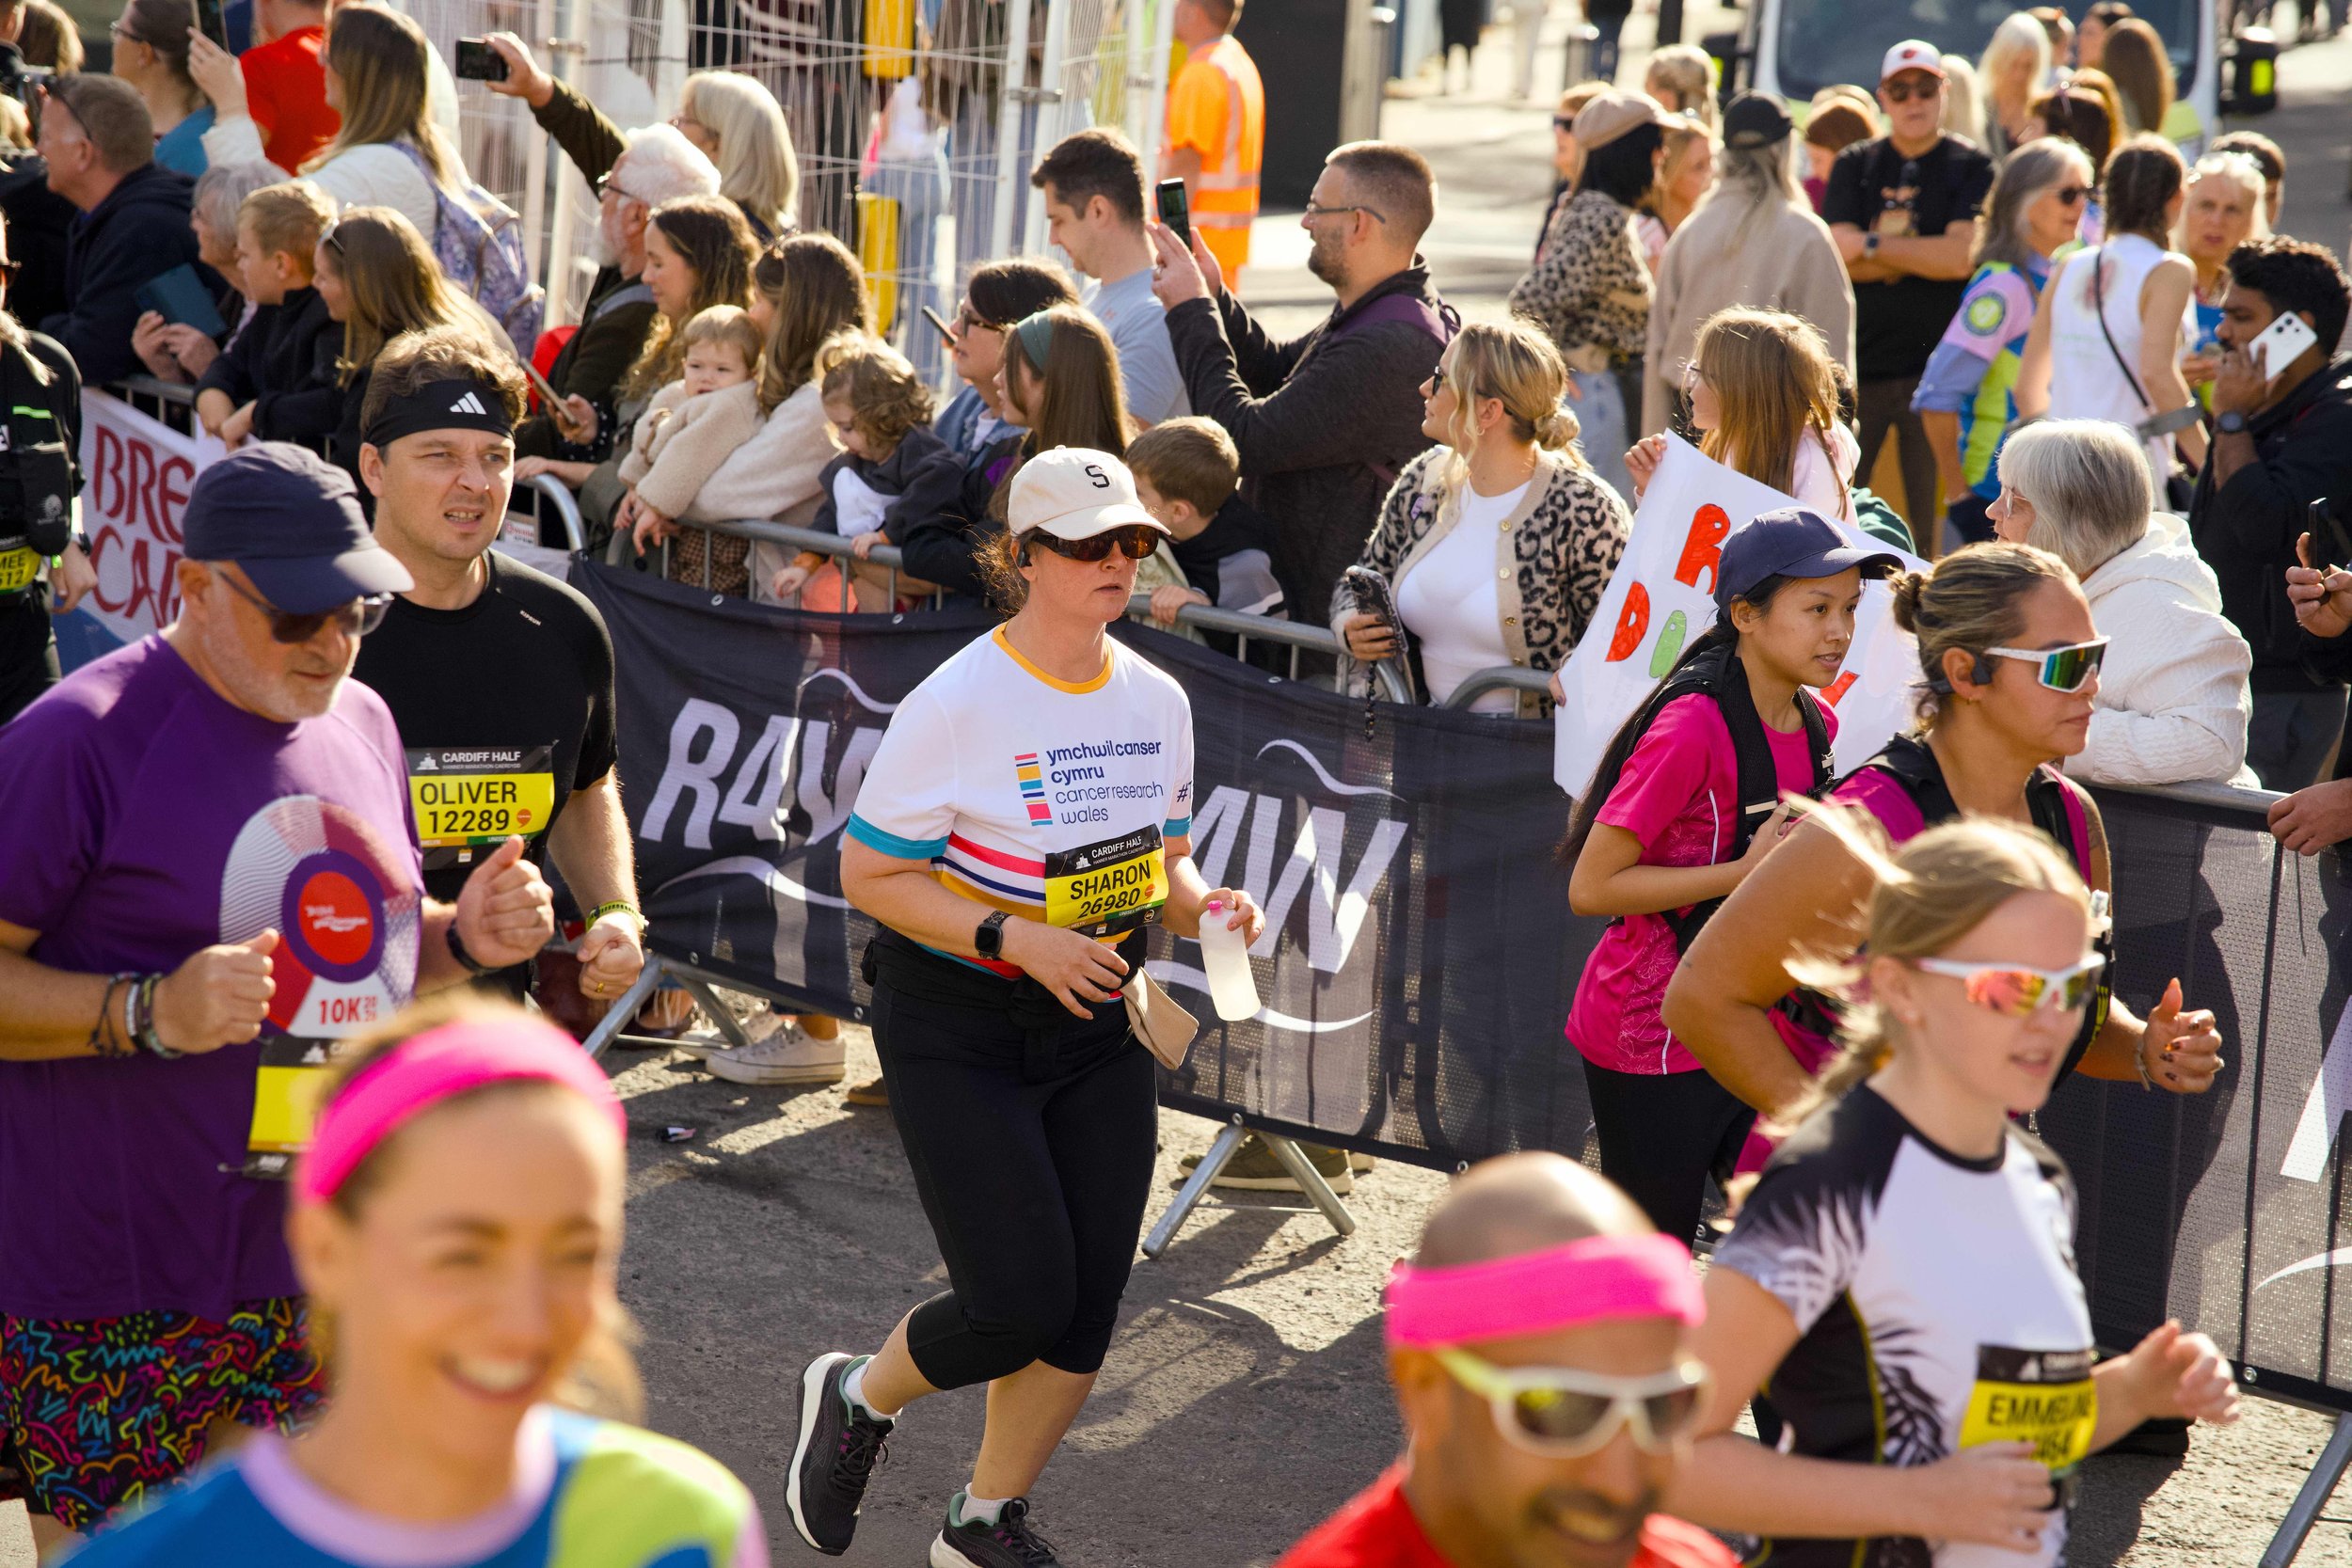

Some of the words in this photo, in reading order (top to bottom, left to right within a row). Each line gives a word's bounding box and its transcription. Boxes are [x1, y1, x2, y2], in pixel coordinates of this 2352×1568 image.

[1085, 464, 1110, 488] S
[441, 752, 489, 763] CARDIFF
[491, 751, 521, 762] HALF
[1046, 740, 1114, 766] ymchwil
[1115, 741, 1162, 756] canser
[1050, 766, 1104, 785] cymru
[420, 781, 516, 805] OLIVER
[1055, 787, 1110, 804] cancer
[1112, 781, 1164, 800] research
[428, 809, 510, 833] 12289
[1060, 805, 1109, 824] wales
[1091, 842, 1124, 859] CARDIFF
[1126, 835, 1142, 849] HALF
[1070, 860, 1151, 900] SHARON
[1077, 887, 1140, 920] 26980
[320, 996, 360, 1025] 10K
